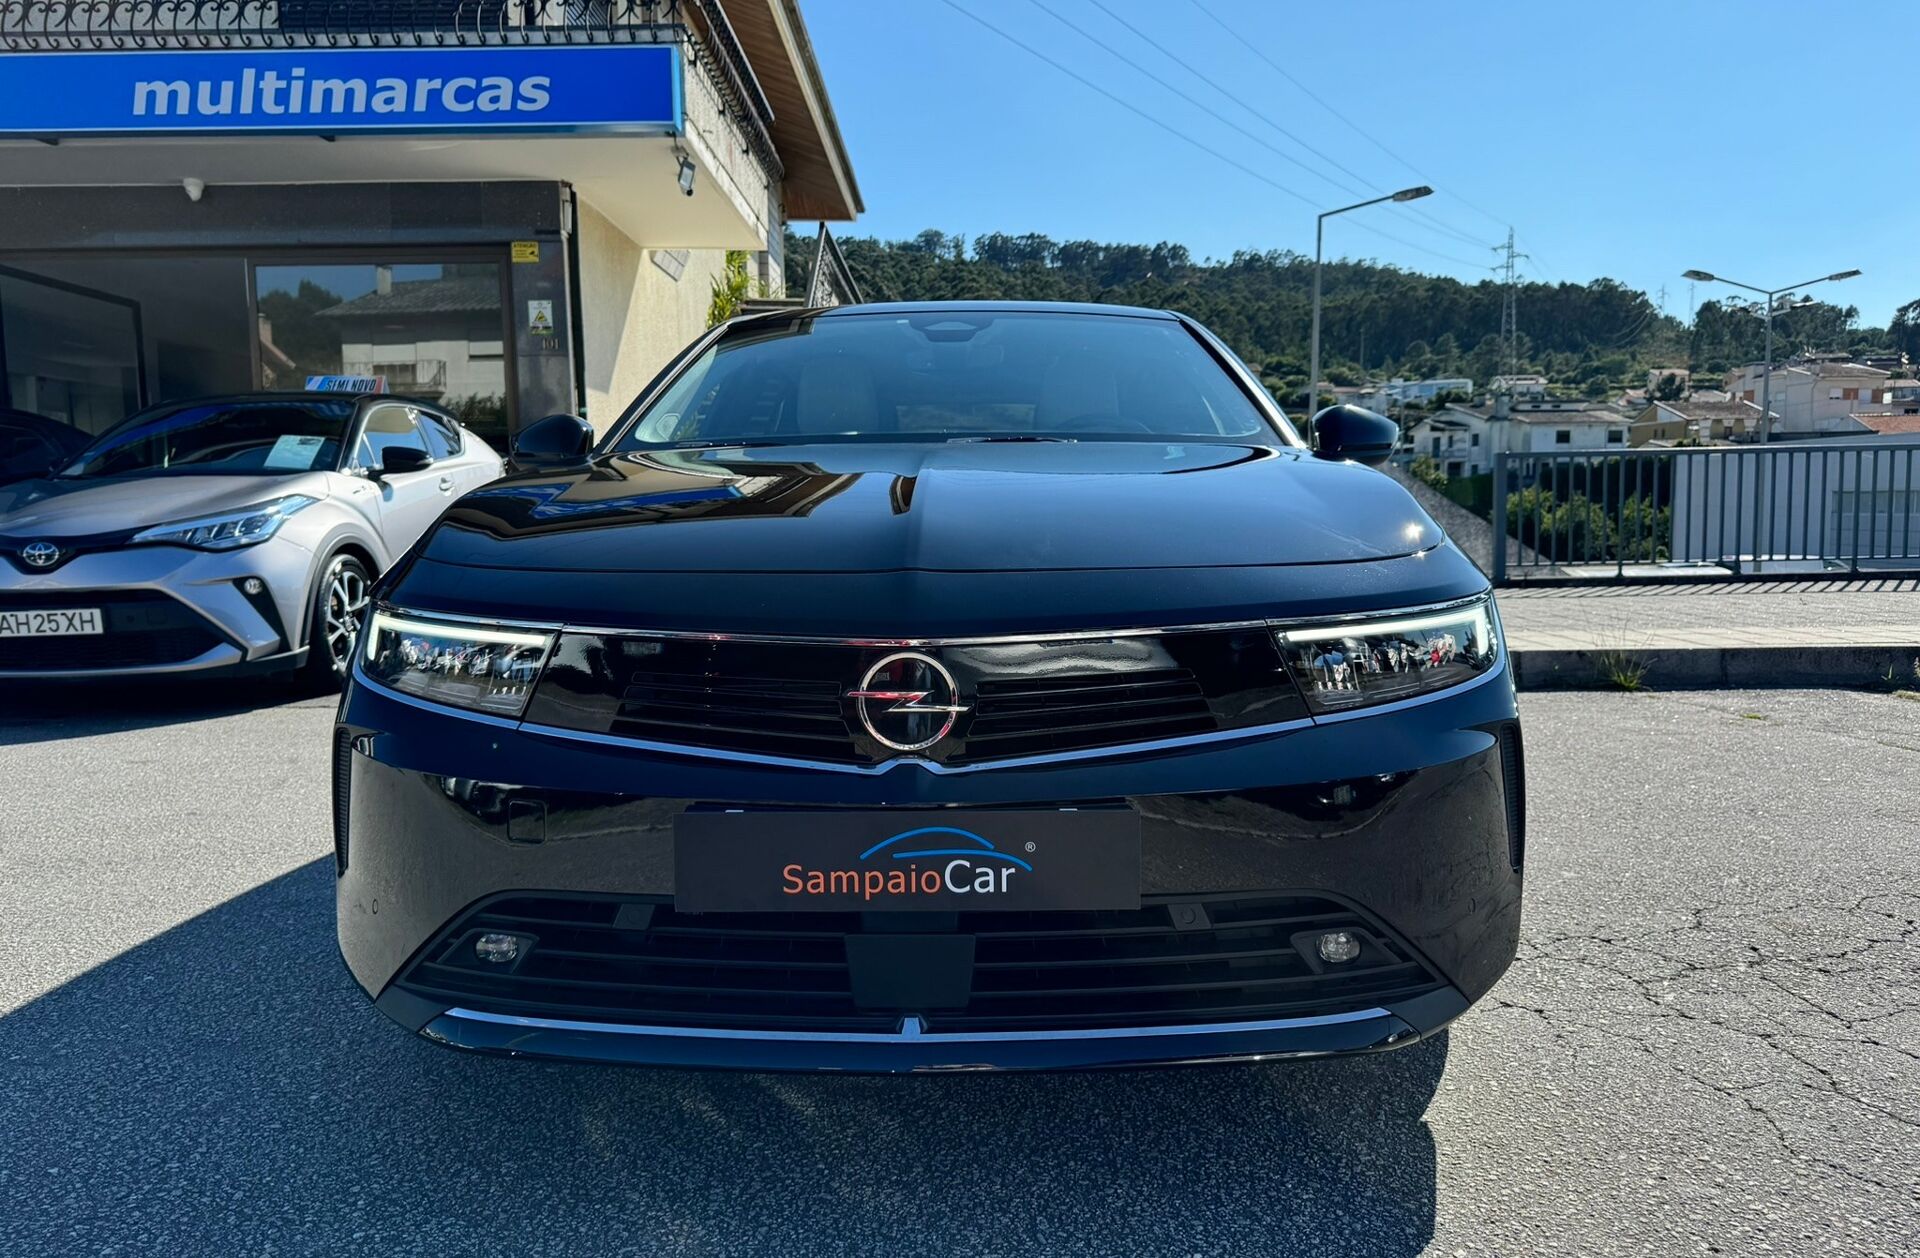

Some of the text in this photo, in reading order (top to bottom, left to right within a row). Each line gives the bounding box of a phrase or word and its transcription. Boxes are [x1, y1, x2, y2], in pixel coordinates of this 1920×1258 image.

[132, 68, 551, 116] multimarcas
[327, 379, 377, 392] SEMI NOVO
[782, 859, 1016, 900] SampaioCar
